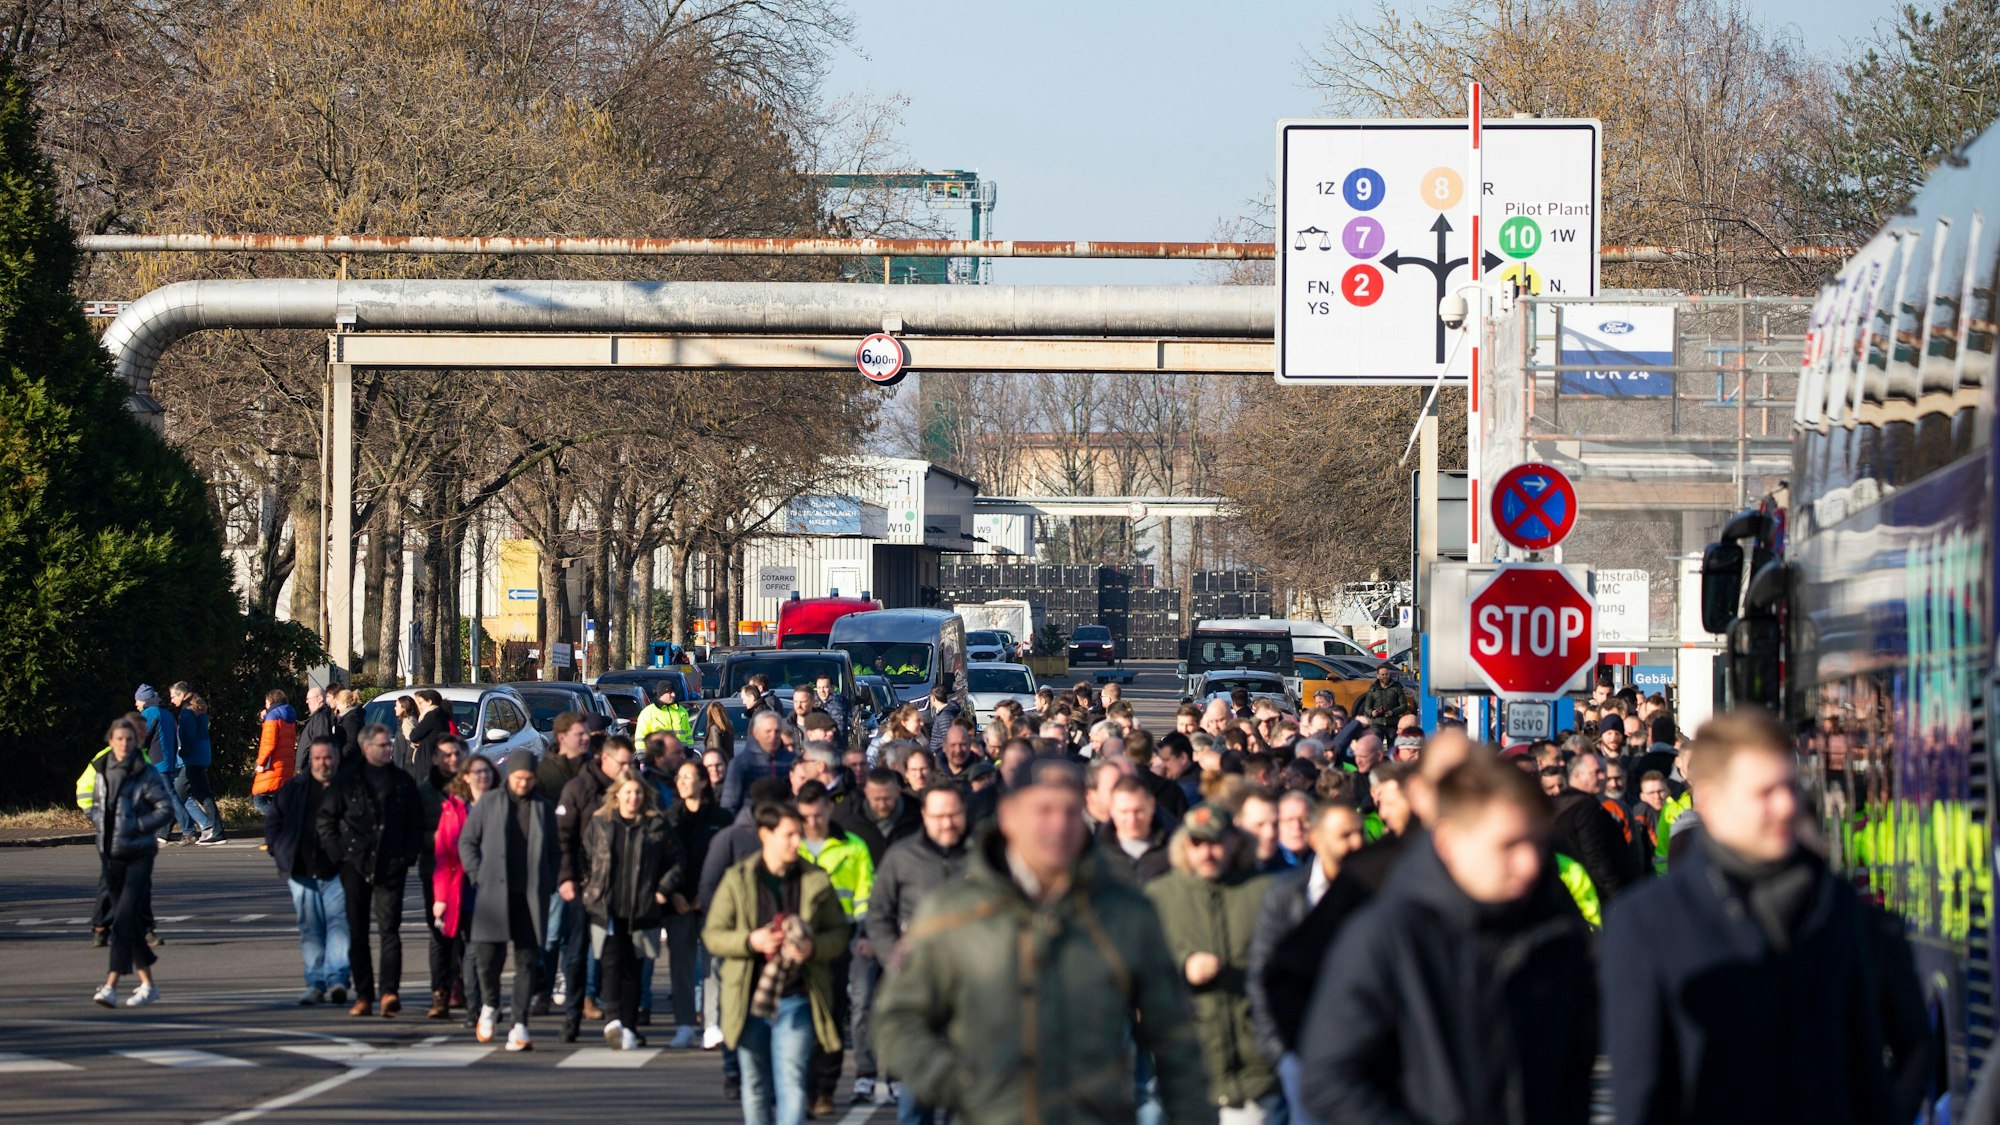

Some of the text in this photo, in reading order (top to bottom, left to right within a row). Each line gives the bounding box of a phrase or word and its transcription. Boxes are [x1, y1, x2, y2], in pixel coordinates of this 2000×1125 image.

[1316, 182, 1335, 195] 1Z
[1355, 177, 1373, 201] 9
[1433, 176, 1450, 200] 8
[1505, 202, 1590, 216] Pilot Plant
[1355, 226, 1372, 249] 7
[1504, 226, 1537, 249] 10
[1550, 229, 1576, 243] 1W
[1308, 281, 1335, 296] FN,
[1353, 273, 1370, 297] 2
[1550, 279, 1566, 294] N,
[1308, 302, 1330, 316] YS
[976, 526, 991, 535] W9
[761, 574, 796, 582] COTARKO
[765, 583, 791, 591] OFFICE
[1477, 604, 1584, 657] STOP
[1512, 718, 1544, 732] StVO
